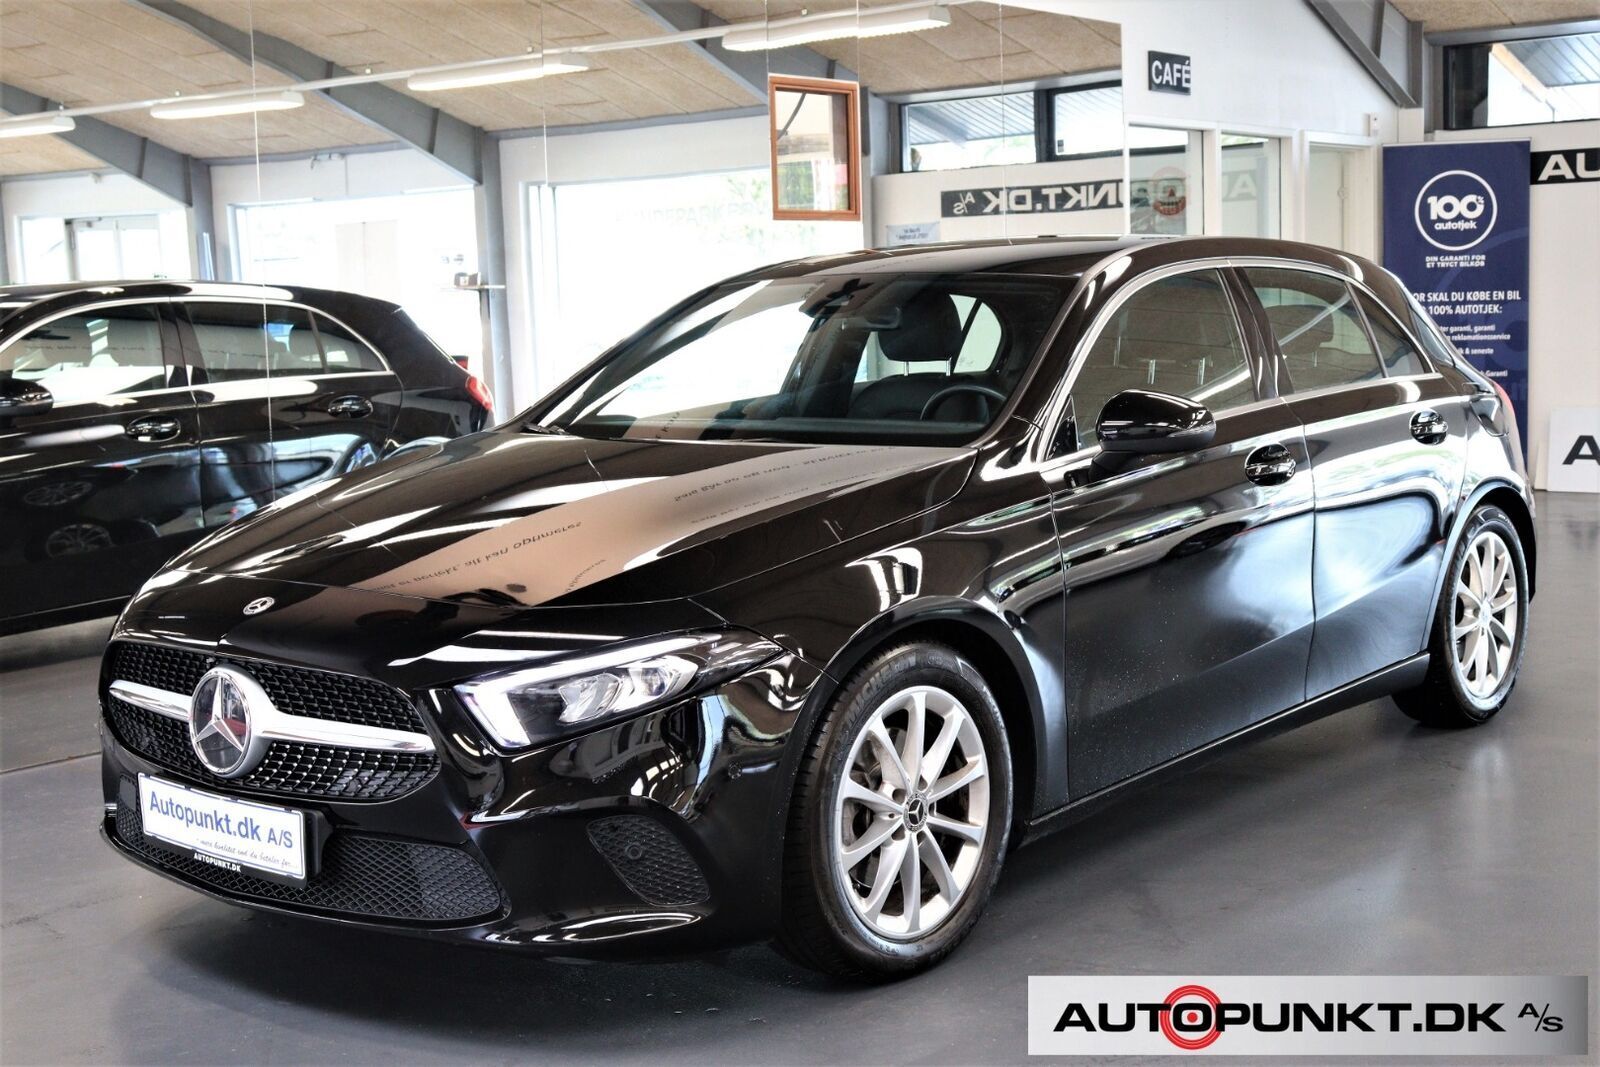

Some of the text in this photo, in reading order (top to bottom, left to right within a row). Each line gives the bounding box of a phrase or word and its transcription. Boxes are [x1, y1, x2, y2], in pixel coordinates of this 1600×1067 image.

[1151, 60, 1191, 88] CAFÉ
[1537, 152, 1600, 181] AU
[1434, 220, 1477, 231] autotjek
[1427, 292, 1450, 302] SKAL
[1451, 291, 1464, 302] DU
[1466, 291, 1491, 301] KØBE
[1492, 291, 1505, 301] EN
[1507, 290, 1521, 300] BIL
[1429, 305, 1454, 315] 100%
[1455, 304, 1503, 315] AUTOTJEK:
[150, 791, 294, 849] Autopunkt.dk A/S
[193, 852, 242, 873] AUTOPUNKT.DK
